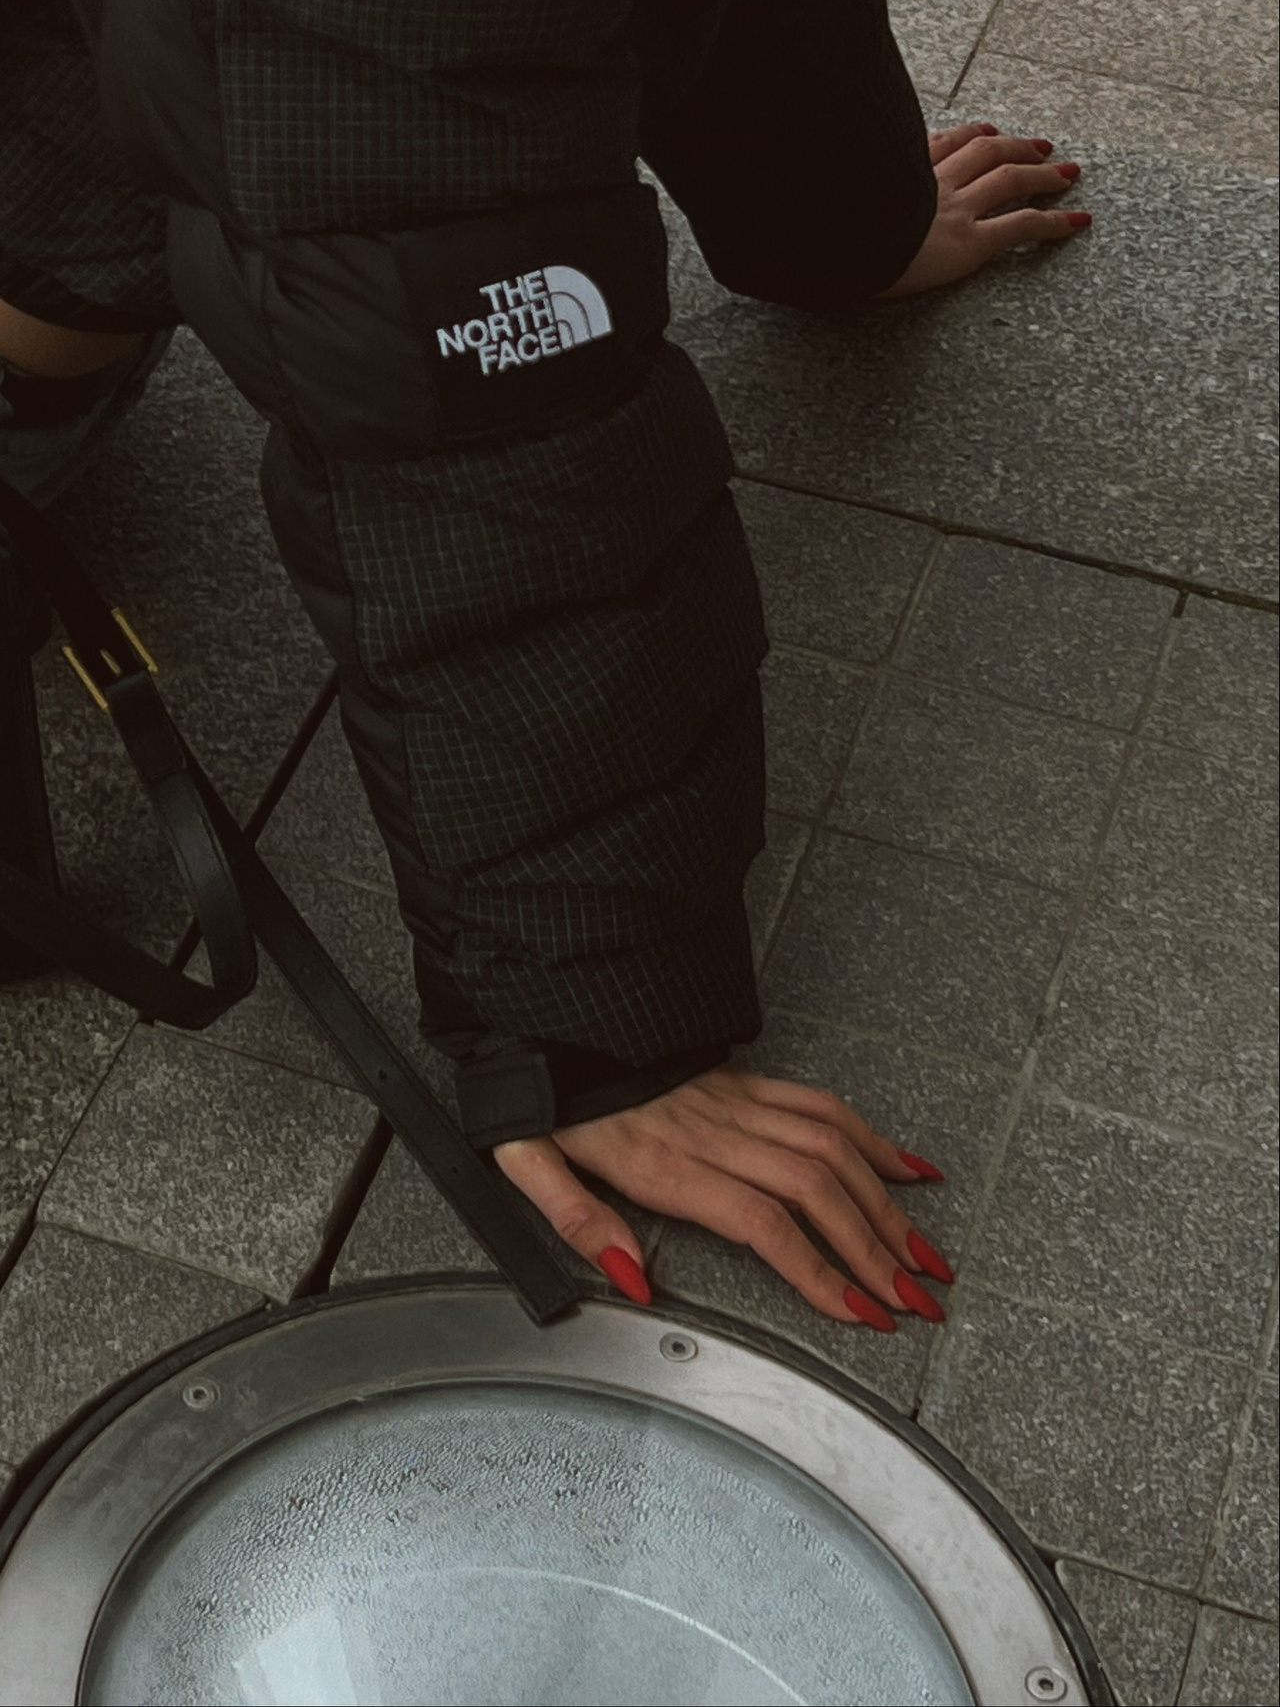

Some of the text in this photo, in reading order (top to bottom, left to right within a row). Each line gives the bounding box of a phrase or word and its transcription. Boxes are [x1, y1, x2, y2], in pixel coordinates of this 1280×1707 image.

[479, 270, 548, 312] THE
[436, 298, 554, 358] NORTH
[478, 325, 561, 376] FACE
